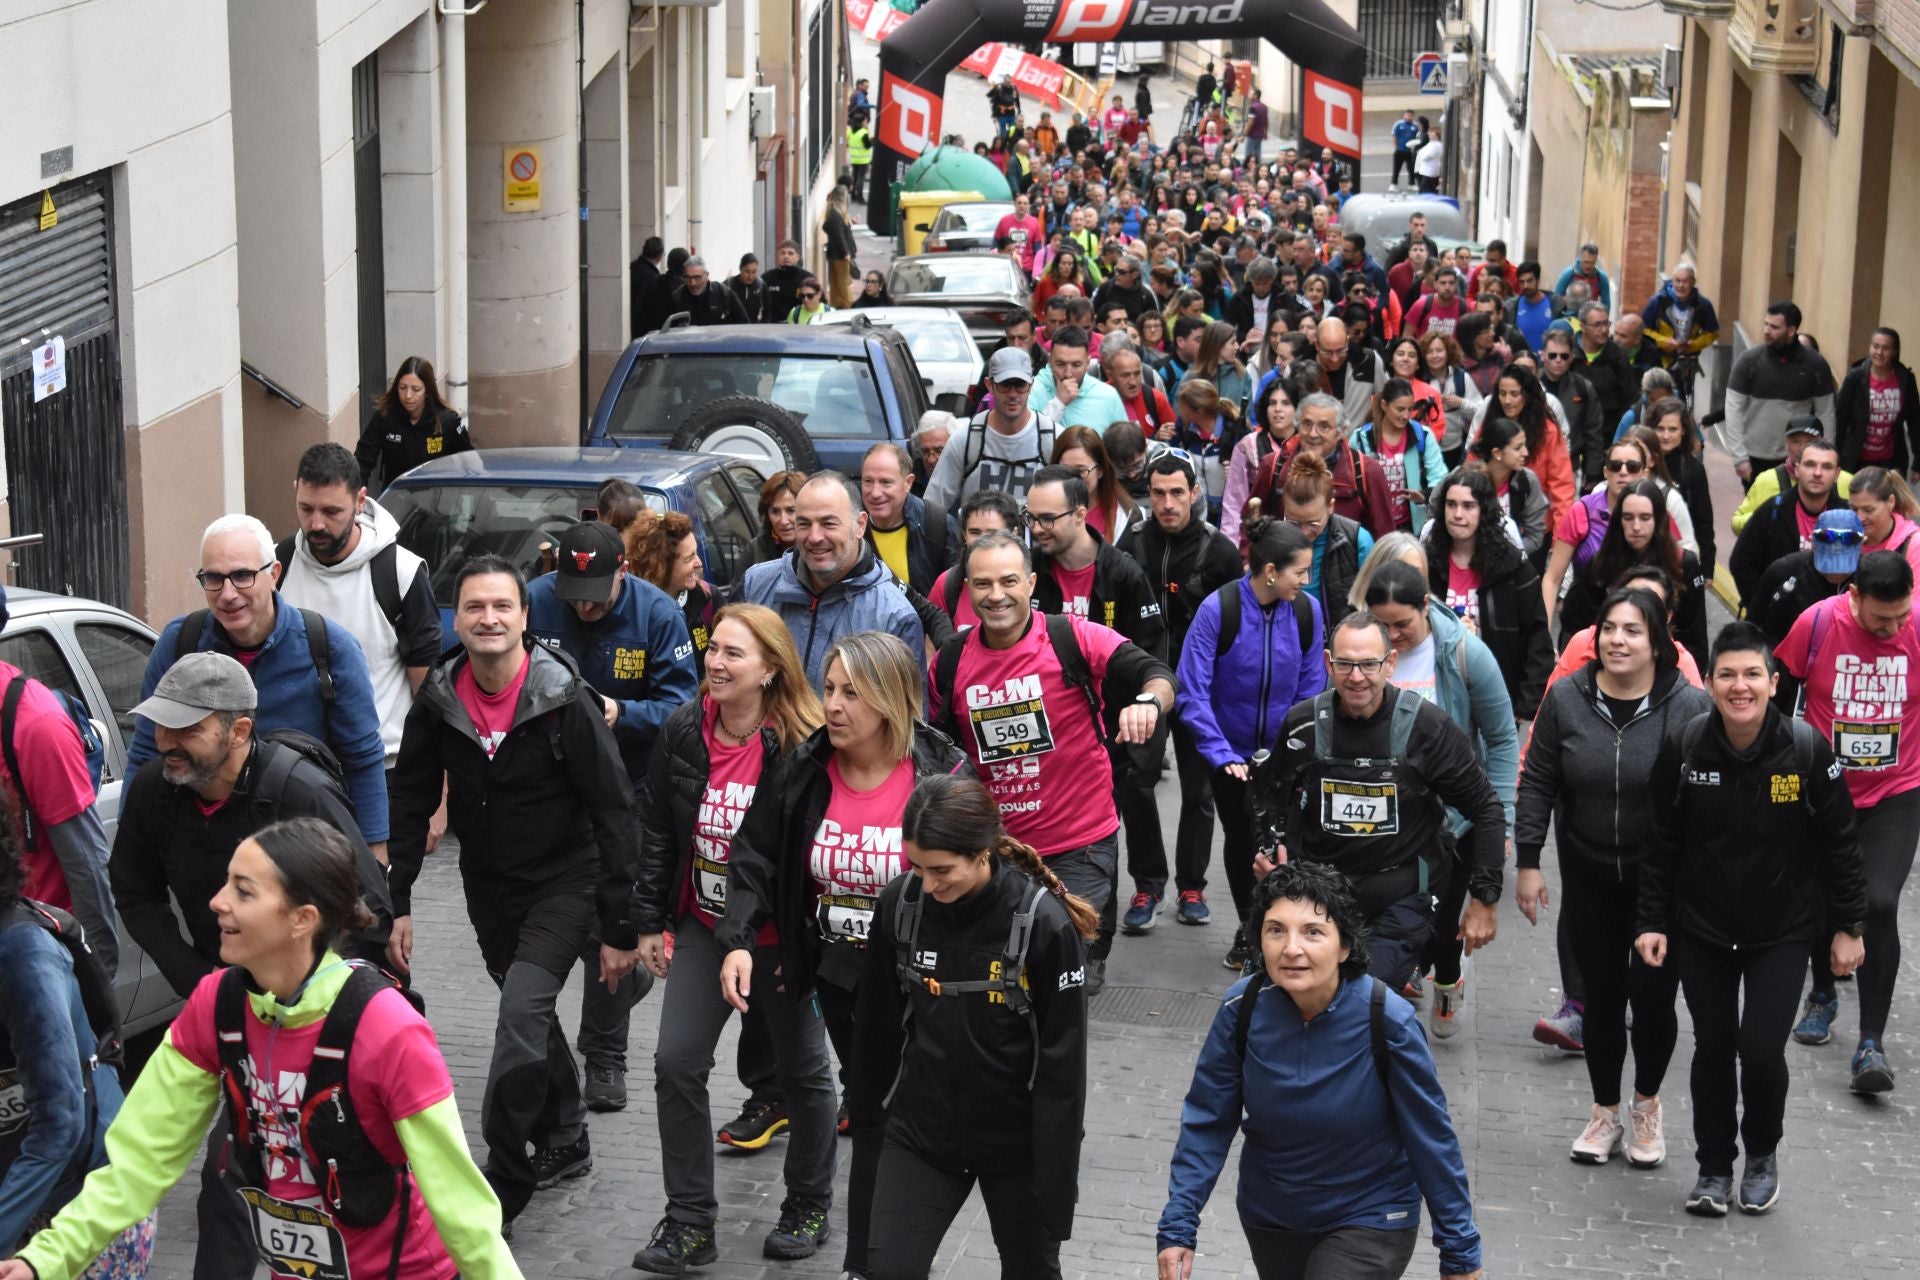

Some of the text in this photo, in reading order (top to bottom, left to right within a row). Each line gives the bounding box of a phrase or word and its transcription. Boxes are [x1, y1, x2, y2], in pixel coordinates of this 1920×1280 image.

[1024, 13, 1050, 21] ON THE
[1026, 5, 1053, 13] STARTS
[615, 647, 646, 659] CxM
[1835, 654, 1908, 676] CxM
[966, 674, 1043, 708] CxM
[995, 723, 1029, 743] 549
[1851, 741, 1882, 755] 652
[1770, 774, 1799, 783] CxM
[1342, 803, 1377, 820] 447
[814, 819, 903, 853] CxM
[270, 1228, 319, 1258] 672
